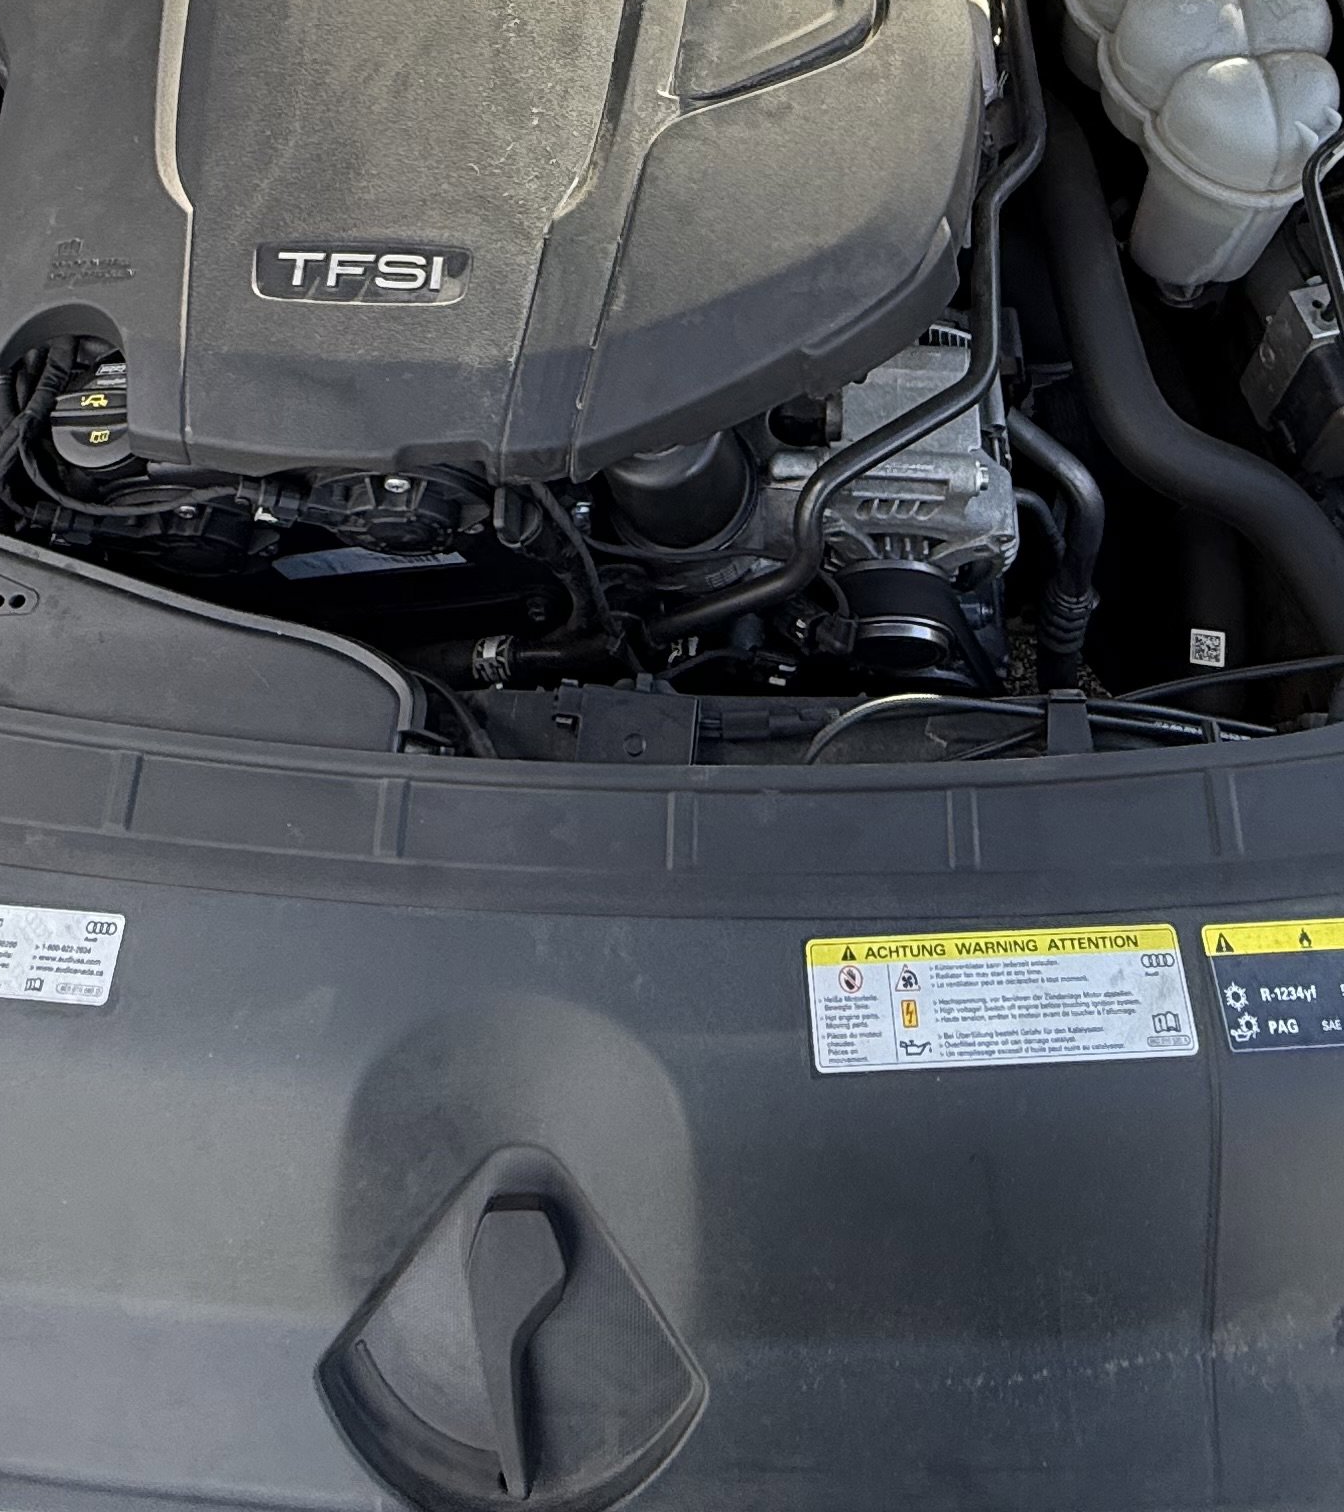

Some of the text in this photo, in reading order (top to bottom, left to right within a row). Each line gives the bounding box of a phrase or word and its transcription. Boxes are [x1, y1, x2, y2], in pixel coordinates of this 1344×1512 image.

[278, 251, 446, 290] TFSI
[864, 934, 1139, 960] ACHTUNG WARNING ATTENTION
[1260, 984, 1317, 1002] R-1234yf
[1268, 1018, 1300, 1034] PAG
[1322, 1019, 1342, 1032] SAE
